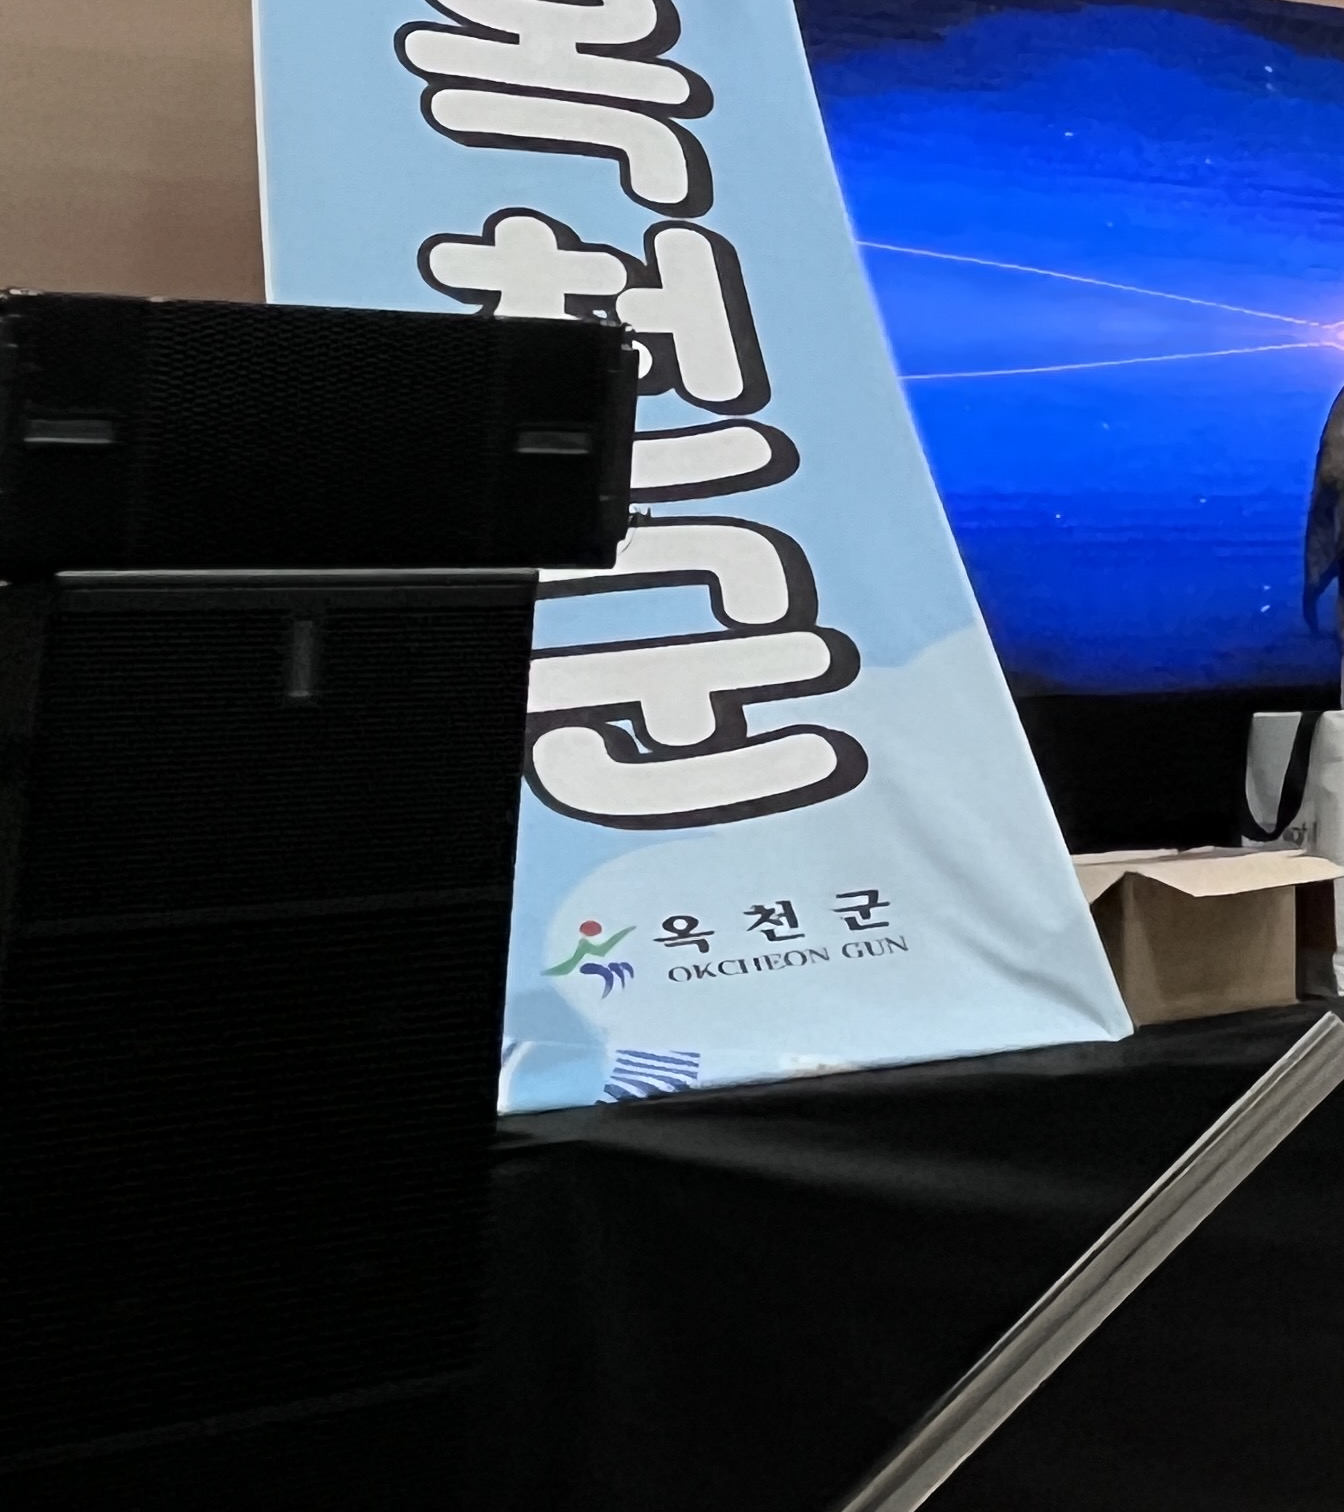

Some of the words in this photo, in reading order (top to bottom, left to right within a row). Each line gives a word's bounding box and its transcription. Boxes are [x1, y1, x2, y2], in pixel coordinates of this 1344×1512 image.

[653, 889, 891, 954] 옥천군
[667, 946, 830, 983] OKCHEON
[841, 935, 910, 960] GUN
